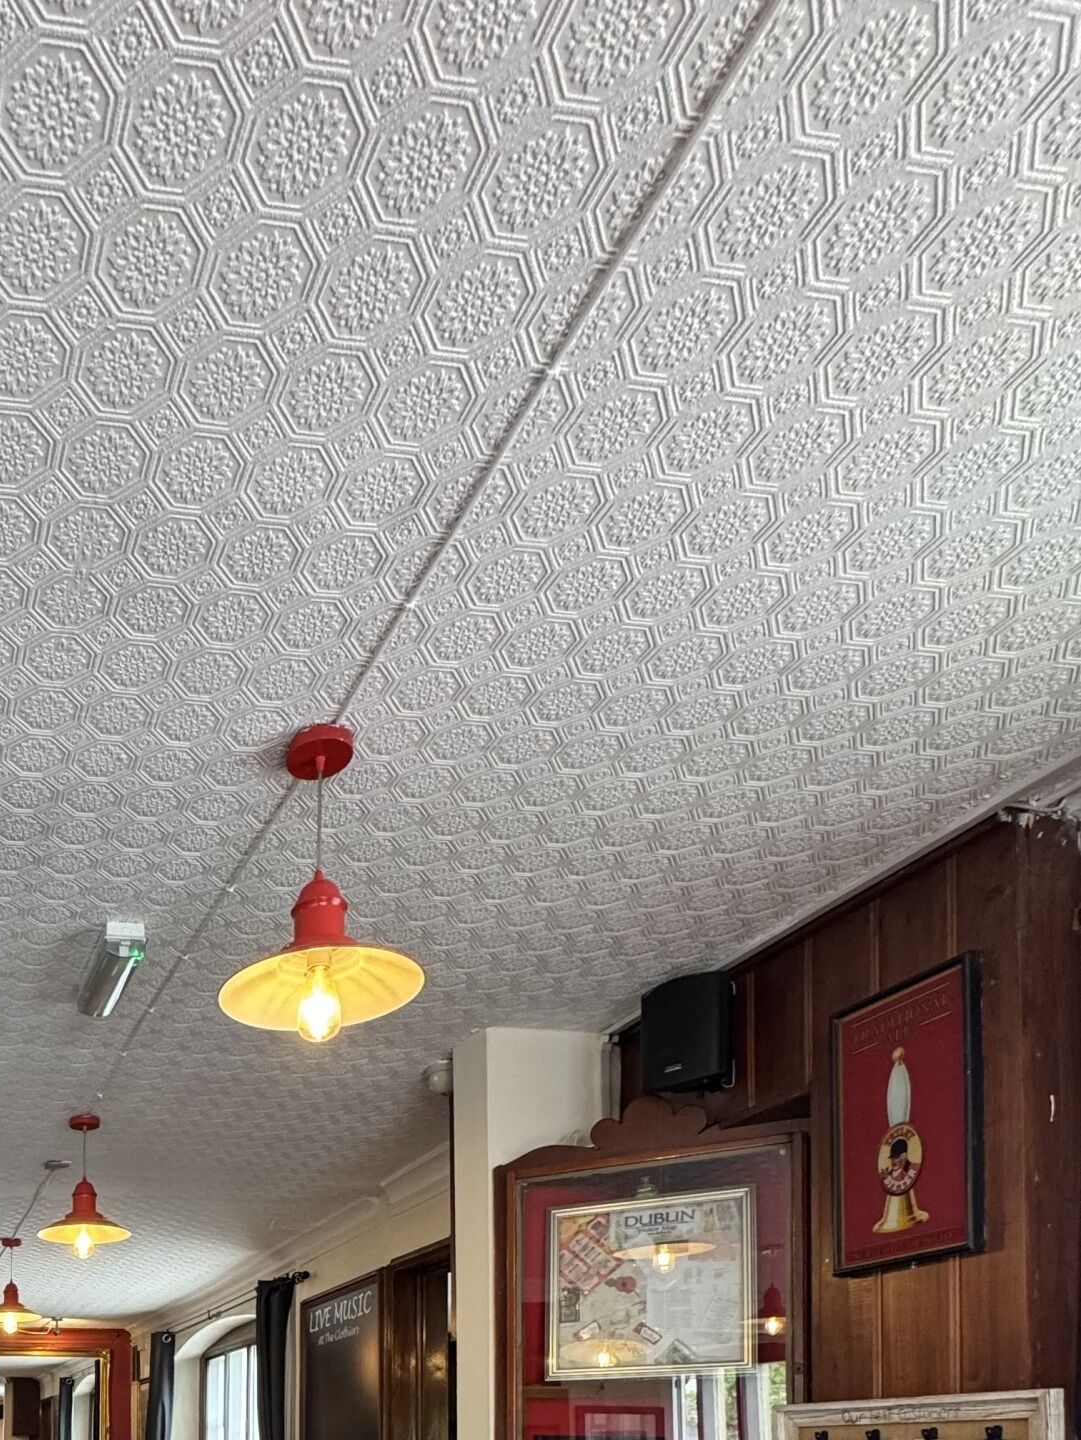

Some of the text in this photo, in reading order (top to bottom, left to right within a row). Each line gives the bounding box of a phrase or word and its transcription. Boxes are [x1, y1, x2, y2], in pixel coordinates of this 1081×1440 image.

[624, 1208, 696, 1228] DUBLIN
[309, 1290, 372, 1333] LIVE MUSIC
